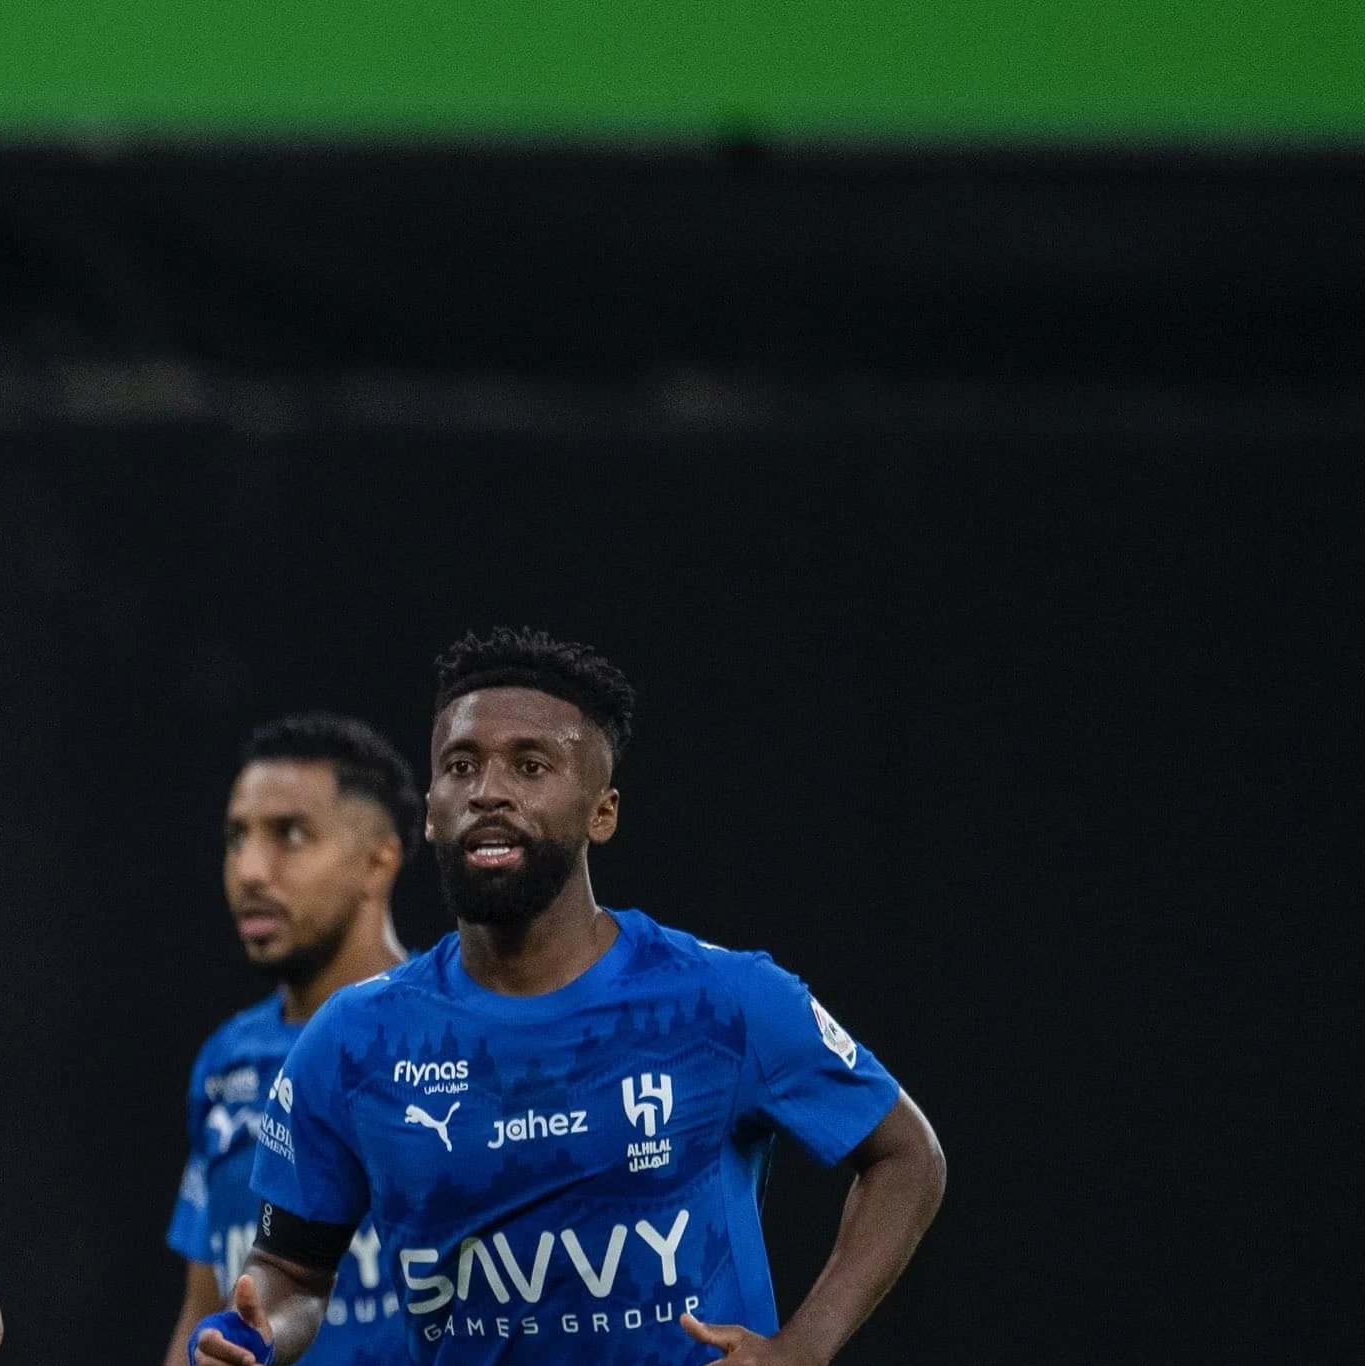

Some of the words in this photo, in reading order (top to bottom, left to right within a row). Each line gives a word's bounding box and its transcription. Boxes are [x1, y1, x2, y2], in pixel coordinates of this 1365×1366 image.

[399, 1208, 690, 1315] SAVVY
[423, 1314, 539, 1342] GAMES
[561, 1295, 699, 1334] GROUP
